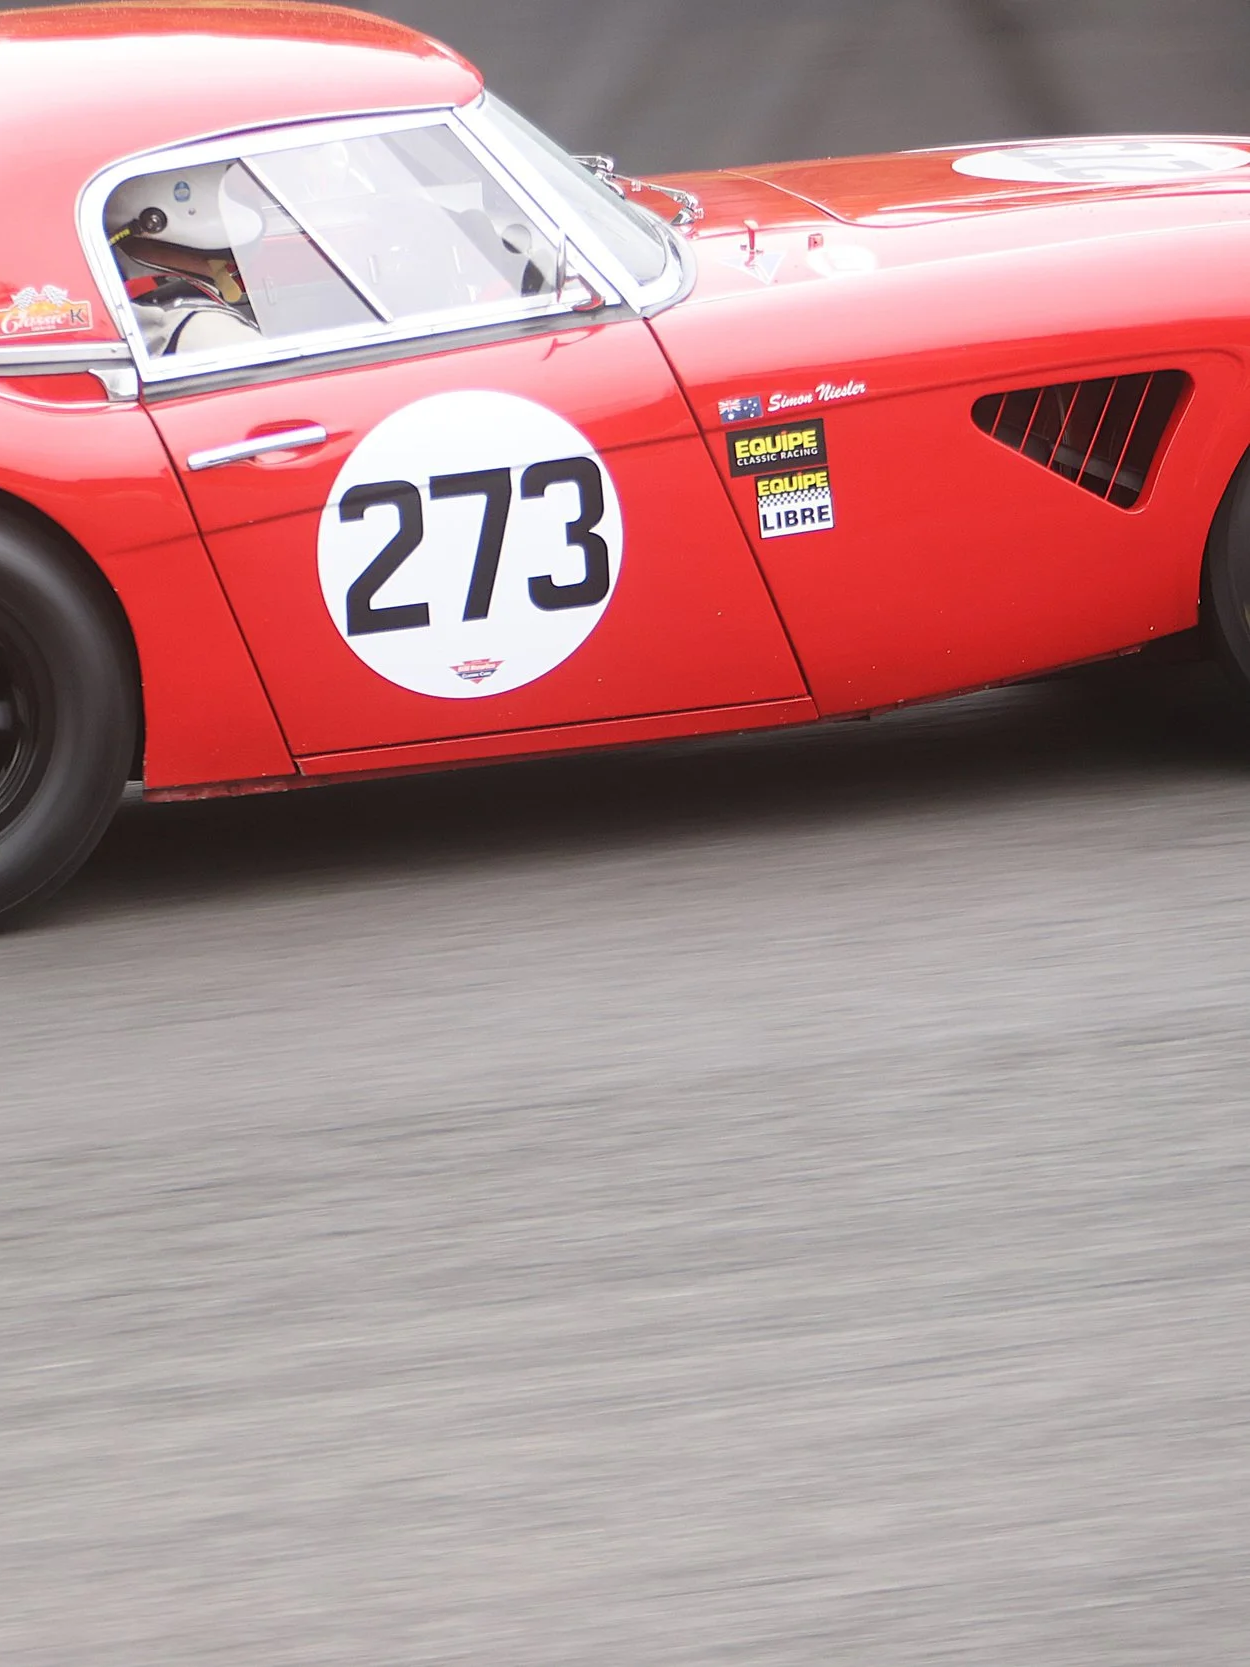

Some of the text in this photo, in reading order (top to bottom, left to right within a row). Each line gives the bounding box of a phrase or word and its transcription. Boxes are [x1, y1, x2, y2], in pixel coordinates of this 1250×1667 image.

[70, 308, 85, 324] K
[767, 393, 812, 412] Simon
[737, 447, 818, 466] CLASSIC RACING
[761, 504, 831, 532] LIBRE
[339, 456, 609, 636] 273
